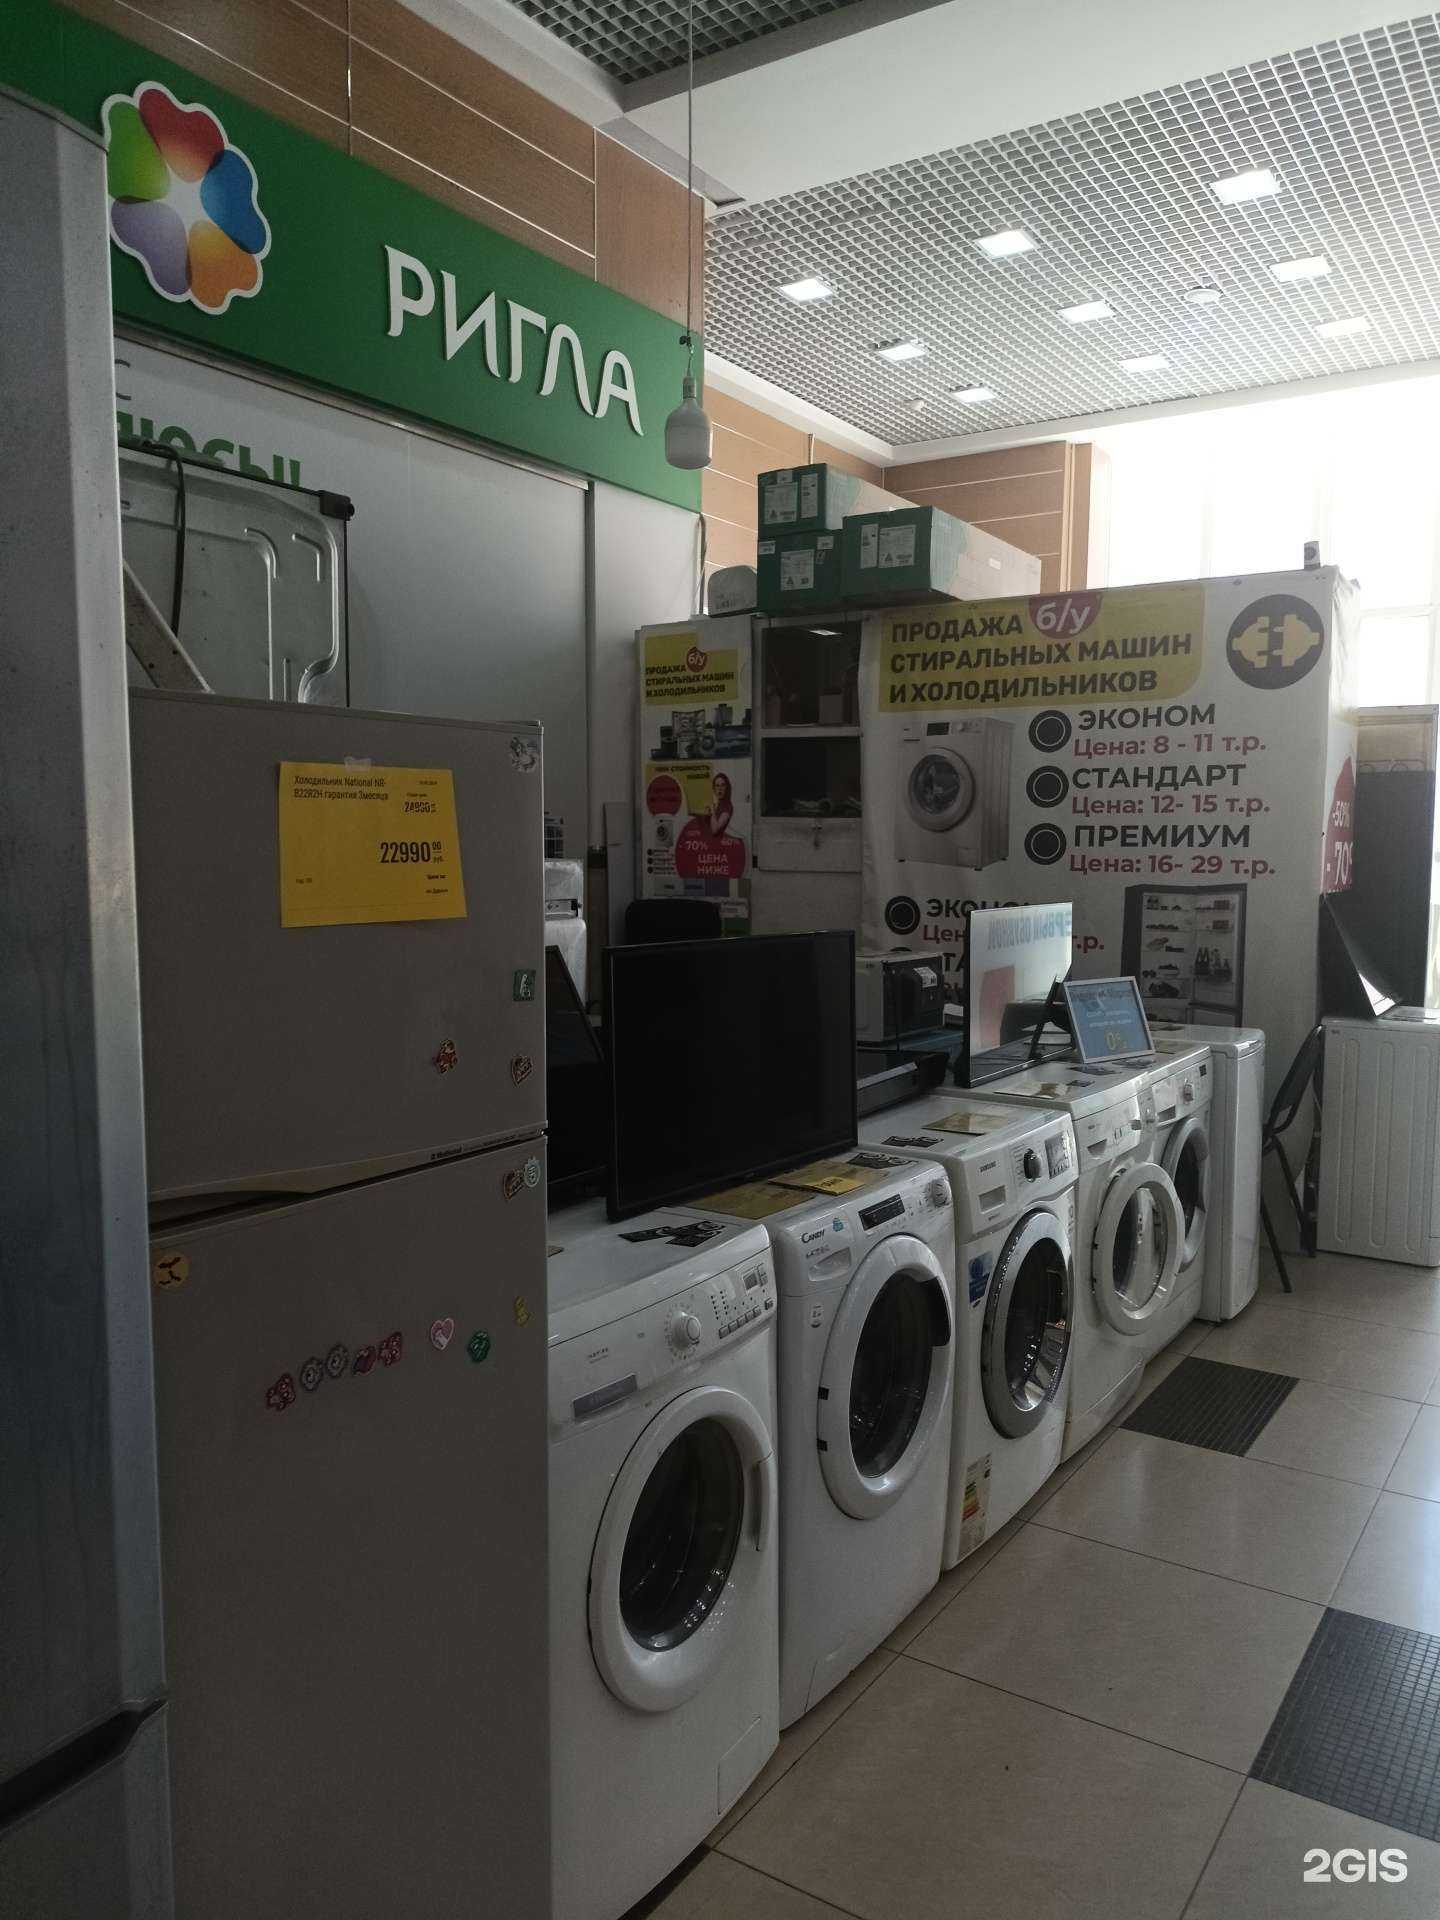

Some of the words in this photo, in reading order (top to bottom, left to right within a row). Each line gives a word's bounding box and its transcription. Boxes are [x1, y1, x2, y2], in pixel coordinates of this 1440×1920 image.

[383, 245, 645, 437] РИГЛА
[1036, 598, 1090, 635] б/у
[891, 614, 1023, 643] ПРОДАЖА
[688, 654, 705, 667] б/у
[890, 642, 1071, 673] СТИРАЛЬНЫХ
[1078, 633, 1191, 661] МАШИН
[645, 665, 687, 675] ПРОДАЖА
[645, 675, 702, 686] СТИРАЛЬНЫХ
[702, 672, 735, 682] МАШИН
[652, 685, 726, 697] ХОЛОДИЛЬНИКОВ
[890, 684, 907, 703] И
[911, 670, 1157, 703] ХОЛОДИЛЬНИКОВ
[1077, 704, 1216, 730] ЭКОНОМ
[1073, 736, 1146, 759] Цена:
[1153, 736, 1170, 754] 8
[1194, 734, 1213, 752] 11
[1222, 735, 1267, 755] т.р.
[294, 776, 343, 786] Холодильник
[1072, 763, 1247, 792] СТАНДАРТ
[1072, 795, 1144, 817] Цена:
[1192, 794, 1218, 813] 15
[1225, 797, 1271, 817] т.р.
[1074, 824, 1251, 848] ПРЕМИУМ
[380, 841, 431, 863] 22990
[697, 853, 729, 864] ЦЕНА
[696, 864, 730, 875] НИЖЕ
[1070, 854, 1141, 877] Цена:
[1191, 854, 1223, 874] 29
[1230, 857, 1276, 878] т.р.
[801, 1229, 825, 1244] CANDY
